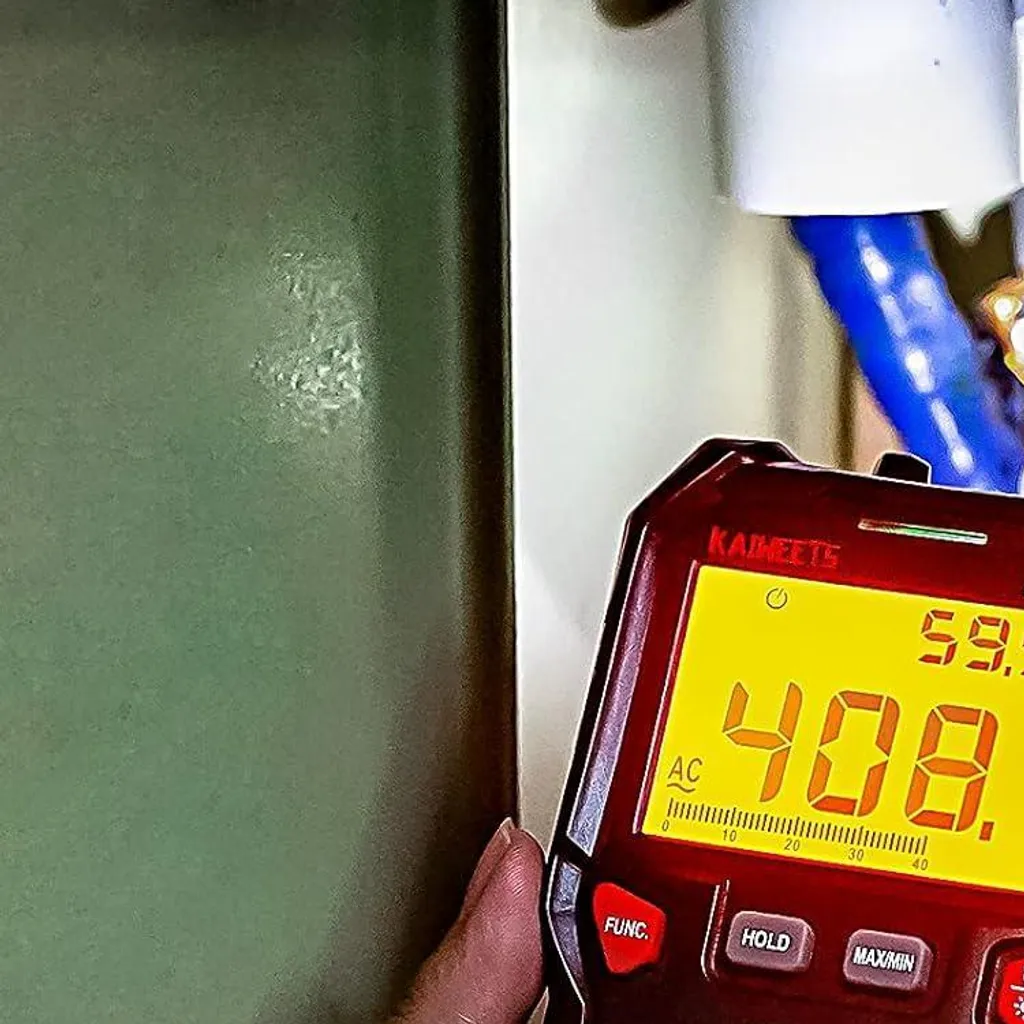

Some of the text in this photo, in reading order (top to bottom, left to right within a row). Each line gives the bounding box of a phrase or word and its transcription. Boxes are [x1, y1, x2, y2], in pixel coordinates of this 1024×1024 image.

[667, 756, 704, 783] AC
[661, 820, 929, 872] 0 10 20 30 40
[604, 916, 649, 941] FUNC.
[741, 927, 791, 953] HOLD
[852, 946, 915, 973] MAX/MIN
